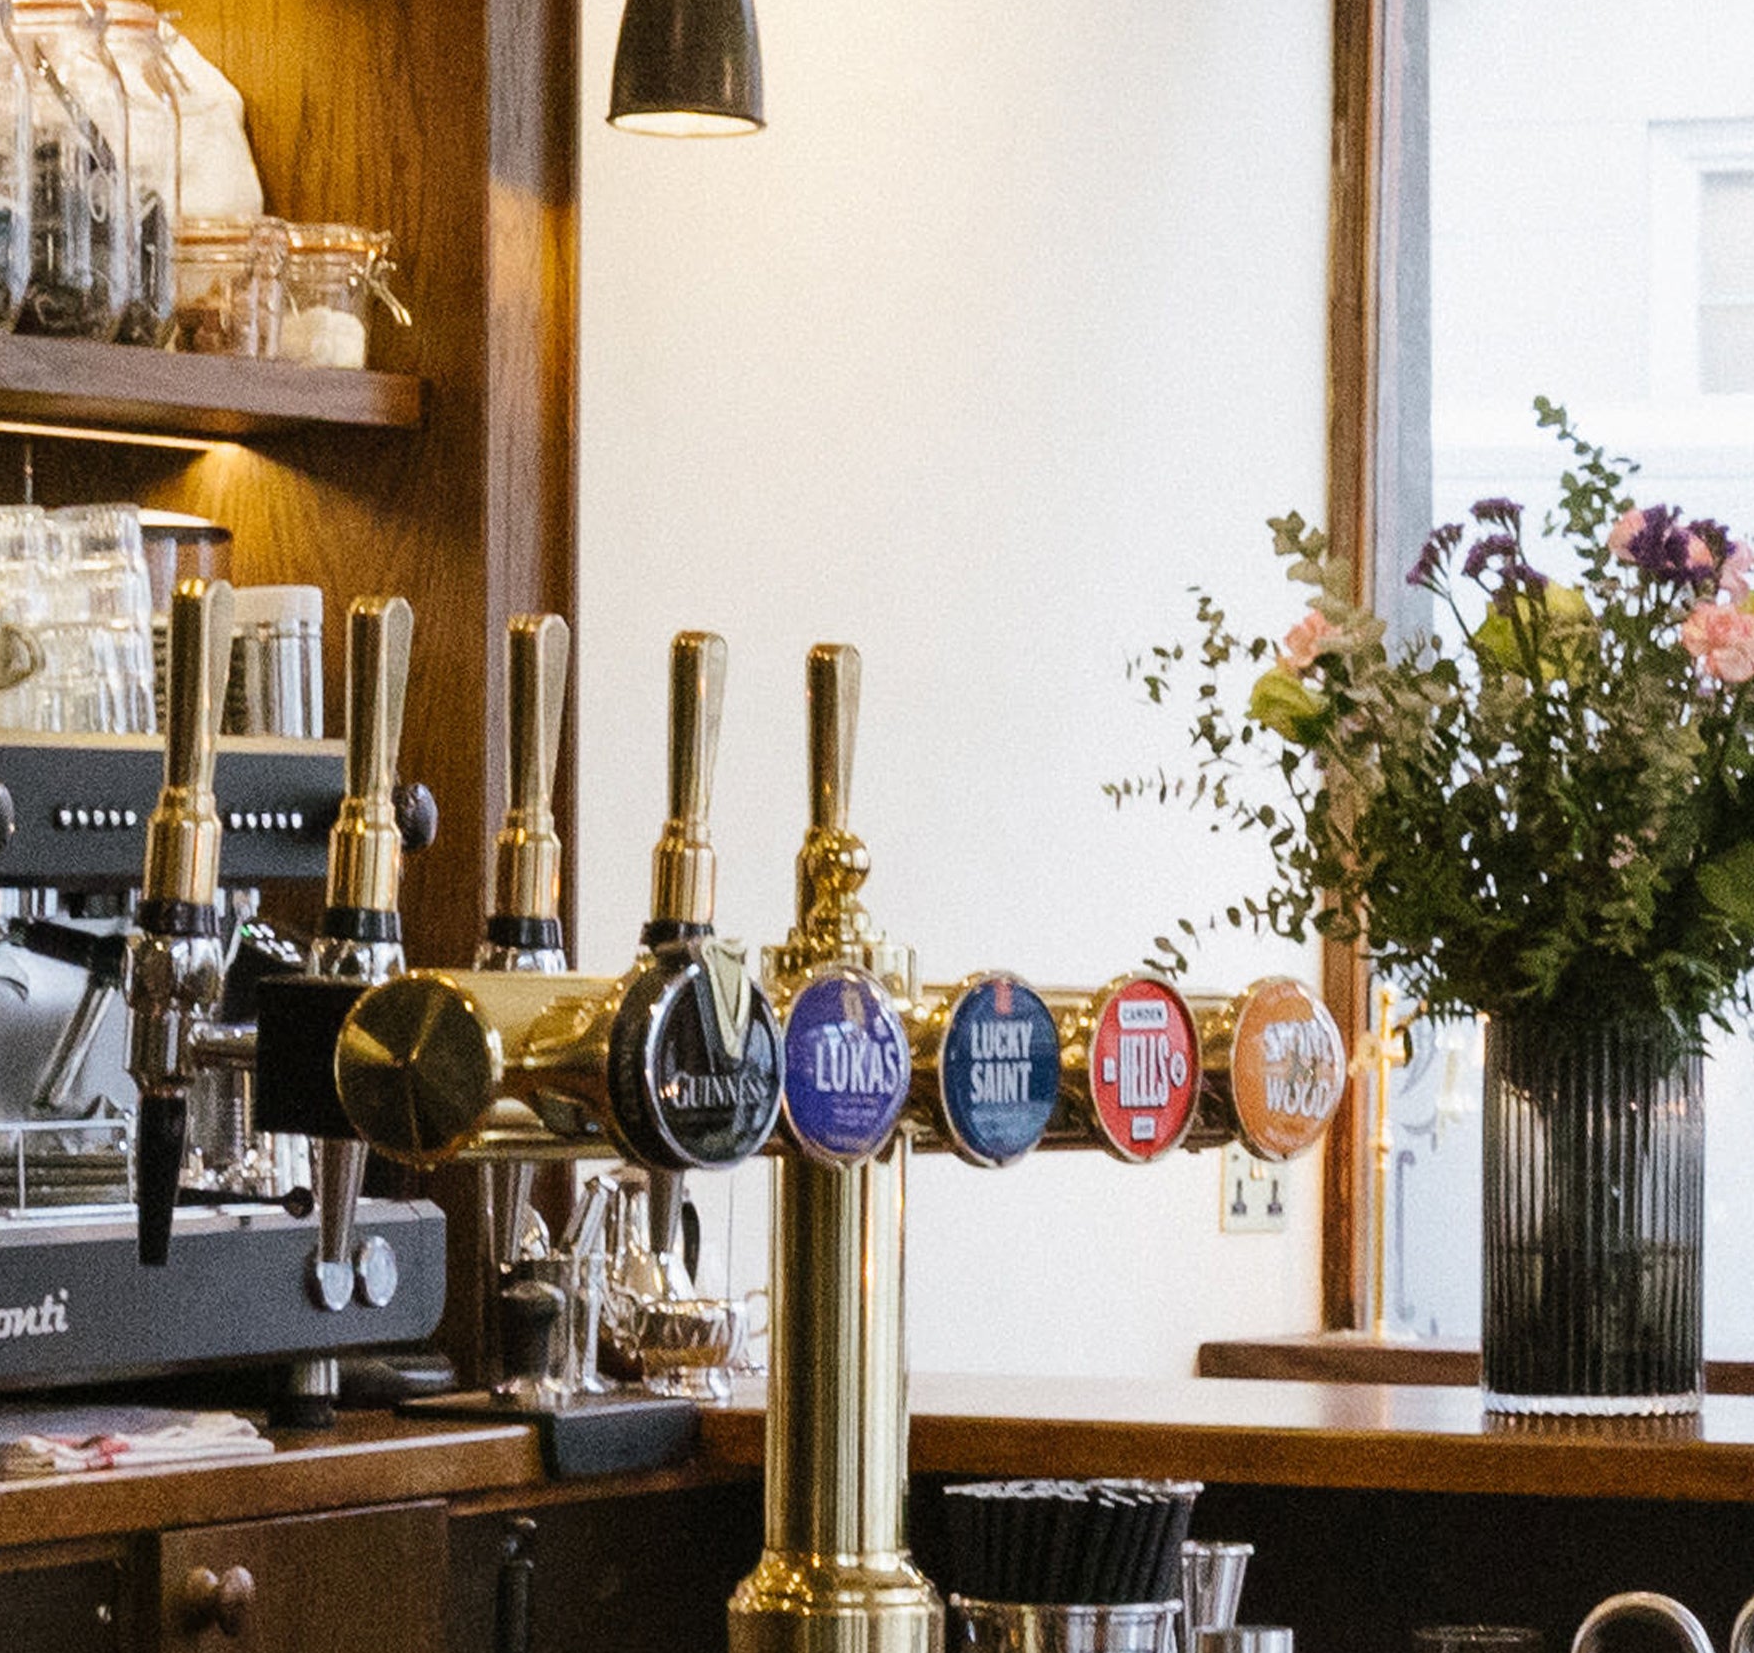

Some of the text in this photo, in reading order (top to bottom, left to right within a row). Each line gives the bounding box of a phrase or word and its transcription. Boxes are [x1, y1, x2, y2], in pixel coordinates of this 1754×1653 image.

[1122, 1006, 1164, 1023] CAMDEN
[970, 1020, 1033, 1060] LUCKY
[815, 1041, 900, 1094] LUKAS
[969, 1061, 1033, 1104] SAINT
[1119, 1033, 1170, 1108] HELLS
[672, 1070, 769, 1109] GUINNESS
[1265, 1076, 1332, 1120] WOOD
